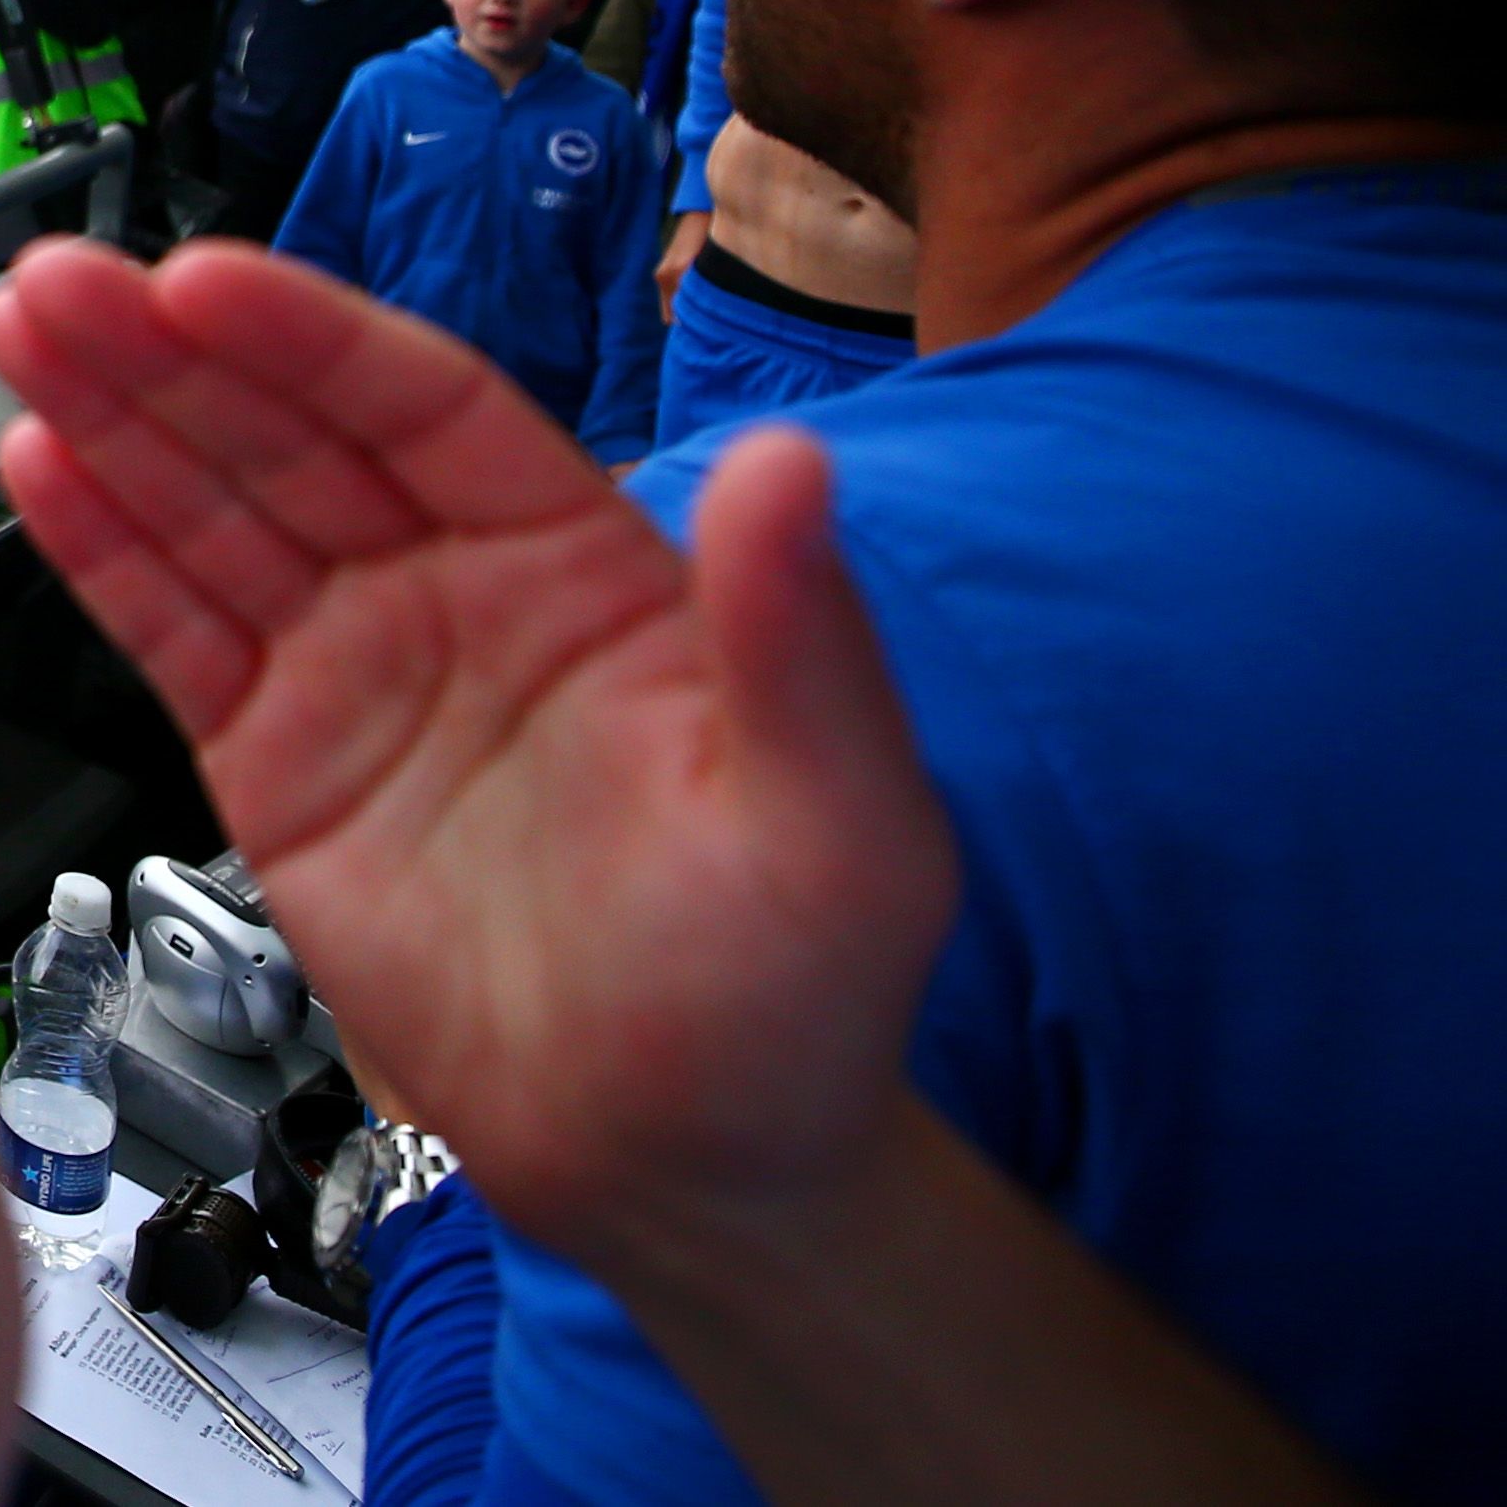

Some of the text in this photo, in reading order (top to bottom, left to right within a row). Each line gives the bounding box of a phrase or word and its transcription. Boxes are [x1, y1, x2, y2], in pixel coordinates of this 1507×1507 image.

[38, 1154, 53, 1207] HYDRO LIFE
[49, 1330, 69, 1353] Albion
